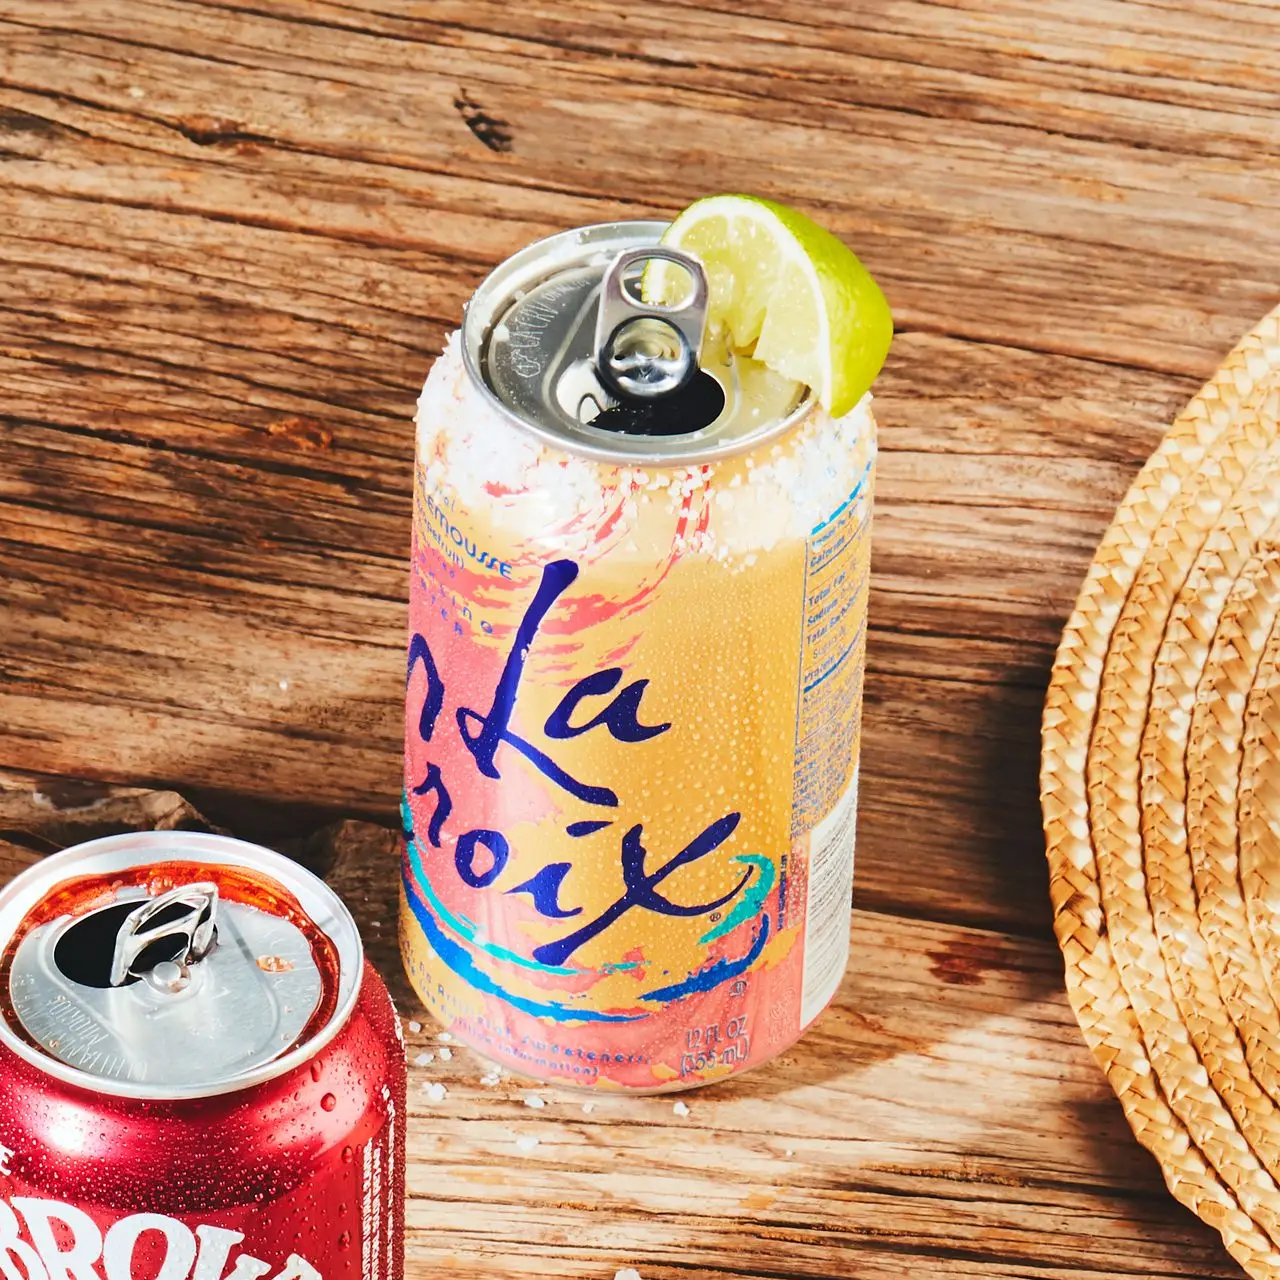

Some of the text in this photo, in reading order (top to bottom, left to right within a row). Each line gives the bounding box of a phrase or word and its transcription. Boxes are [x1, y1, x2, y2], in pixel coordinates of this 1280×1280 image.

[456, 560, 673, 808] La
[686, 1028, 704, 1049] 12
[726, 1014, 749, 1039] OZ
